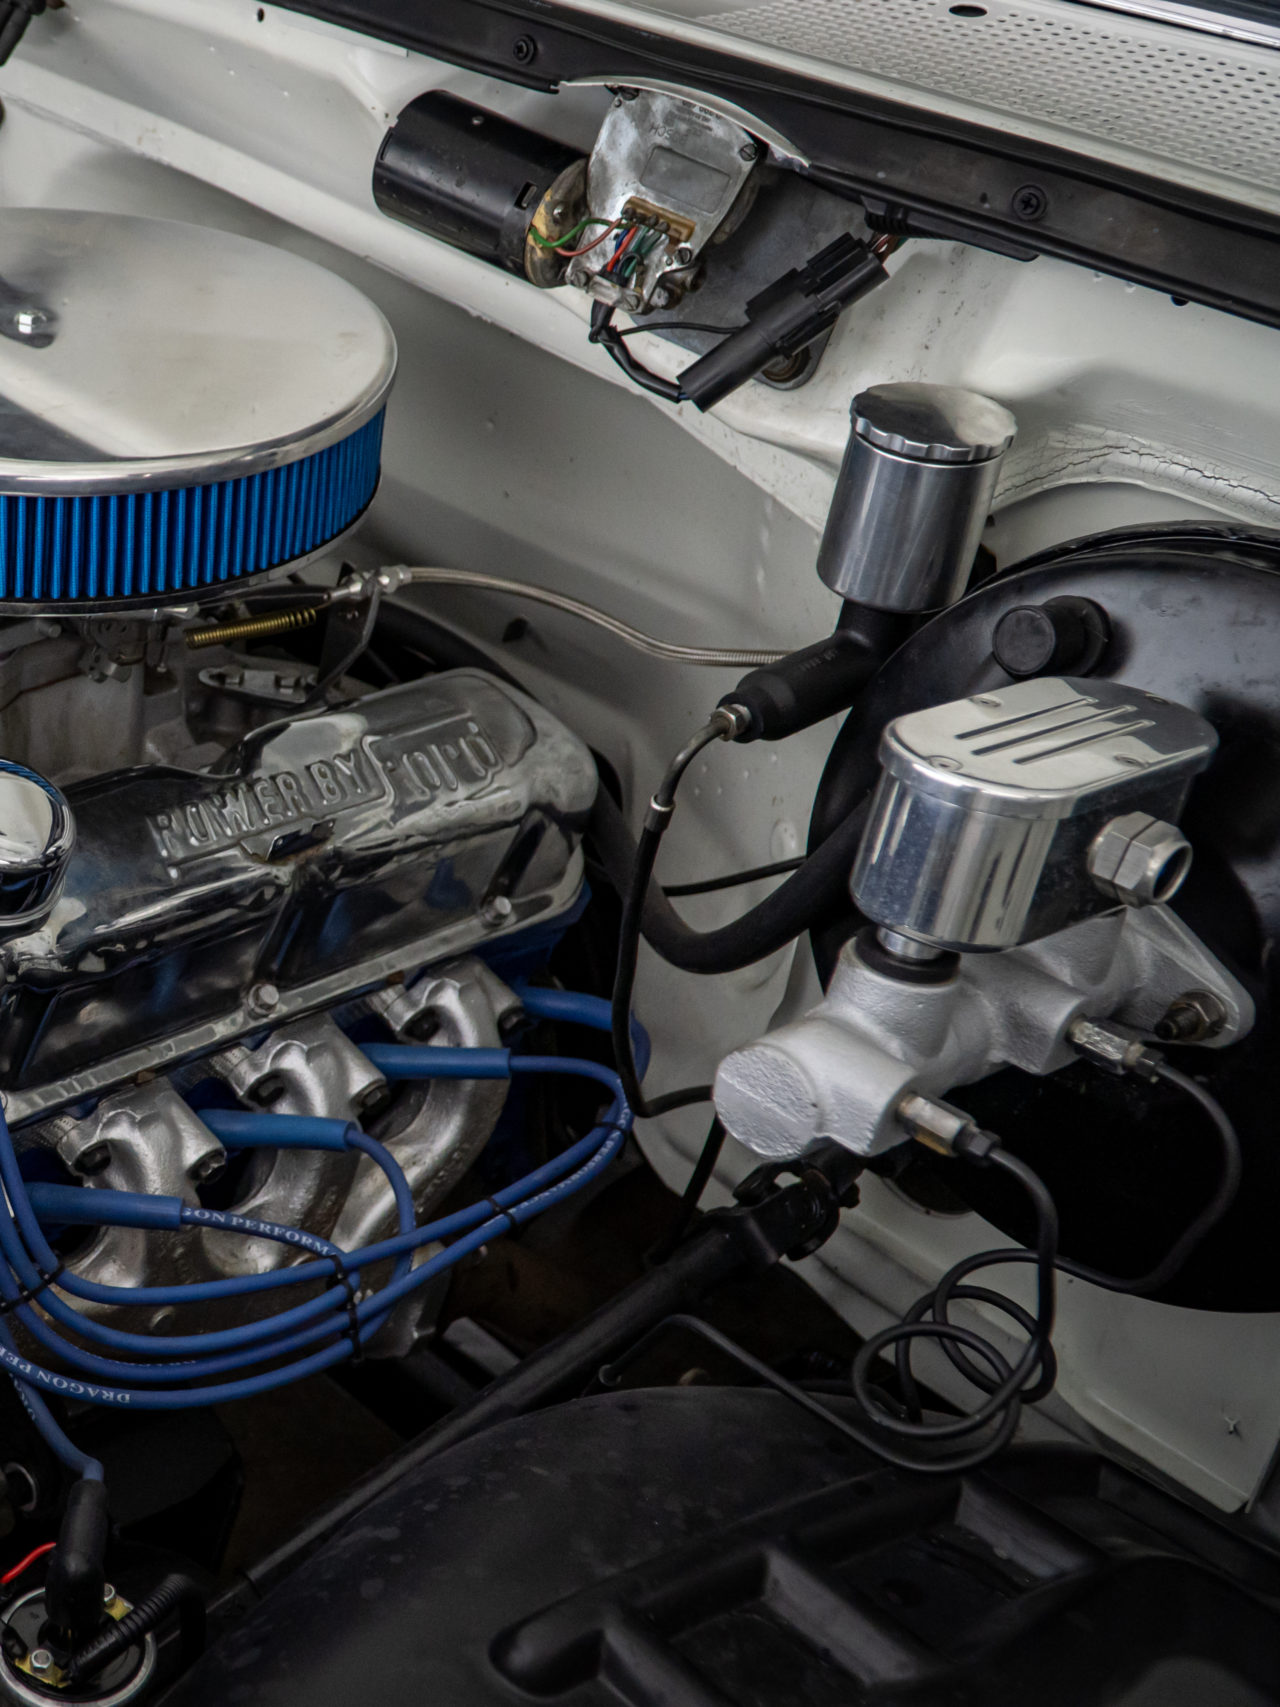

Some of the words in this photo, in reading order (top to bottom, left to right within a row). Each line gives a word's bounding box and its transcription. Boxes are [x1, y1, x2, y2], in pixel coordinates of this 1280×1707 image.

[146, 772, 310, 860] POWER
[308, 749, 368, 806] BY
[36, 1370, 131, 1404] DRAGON
